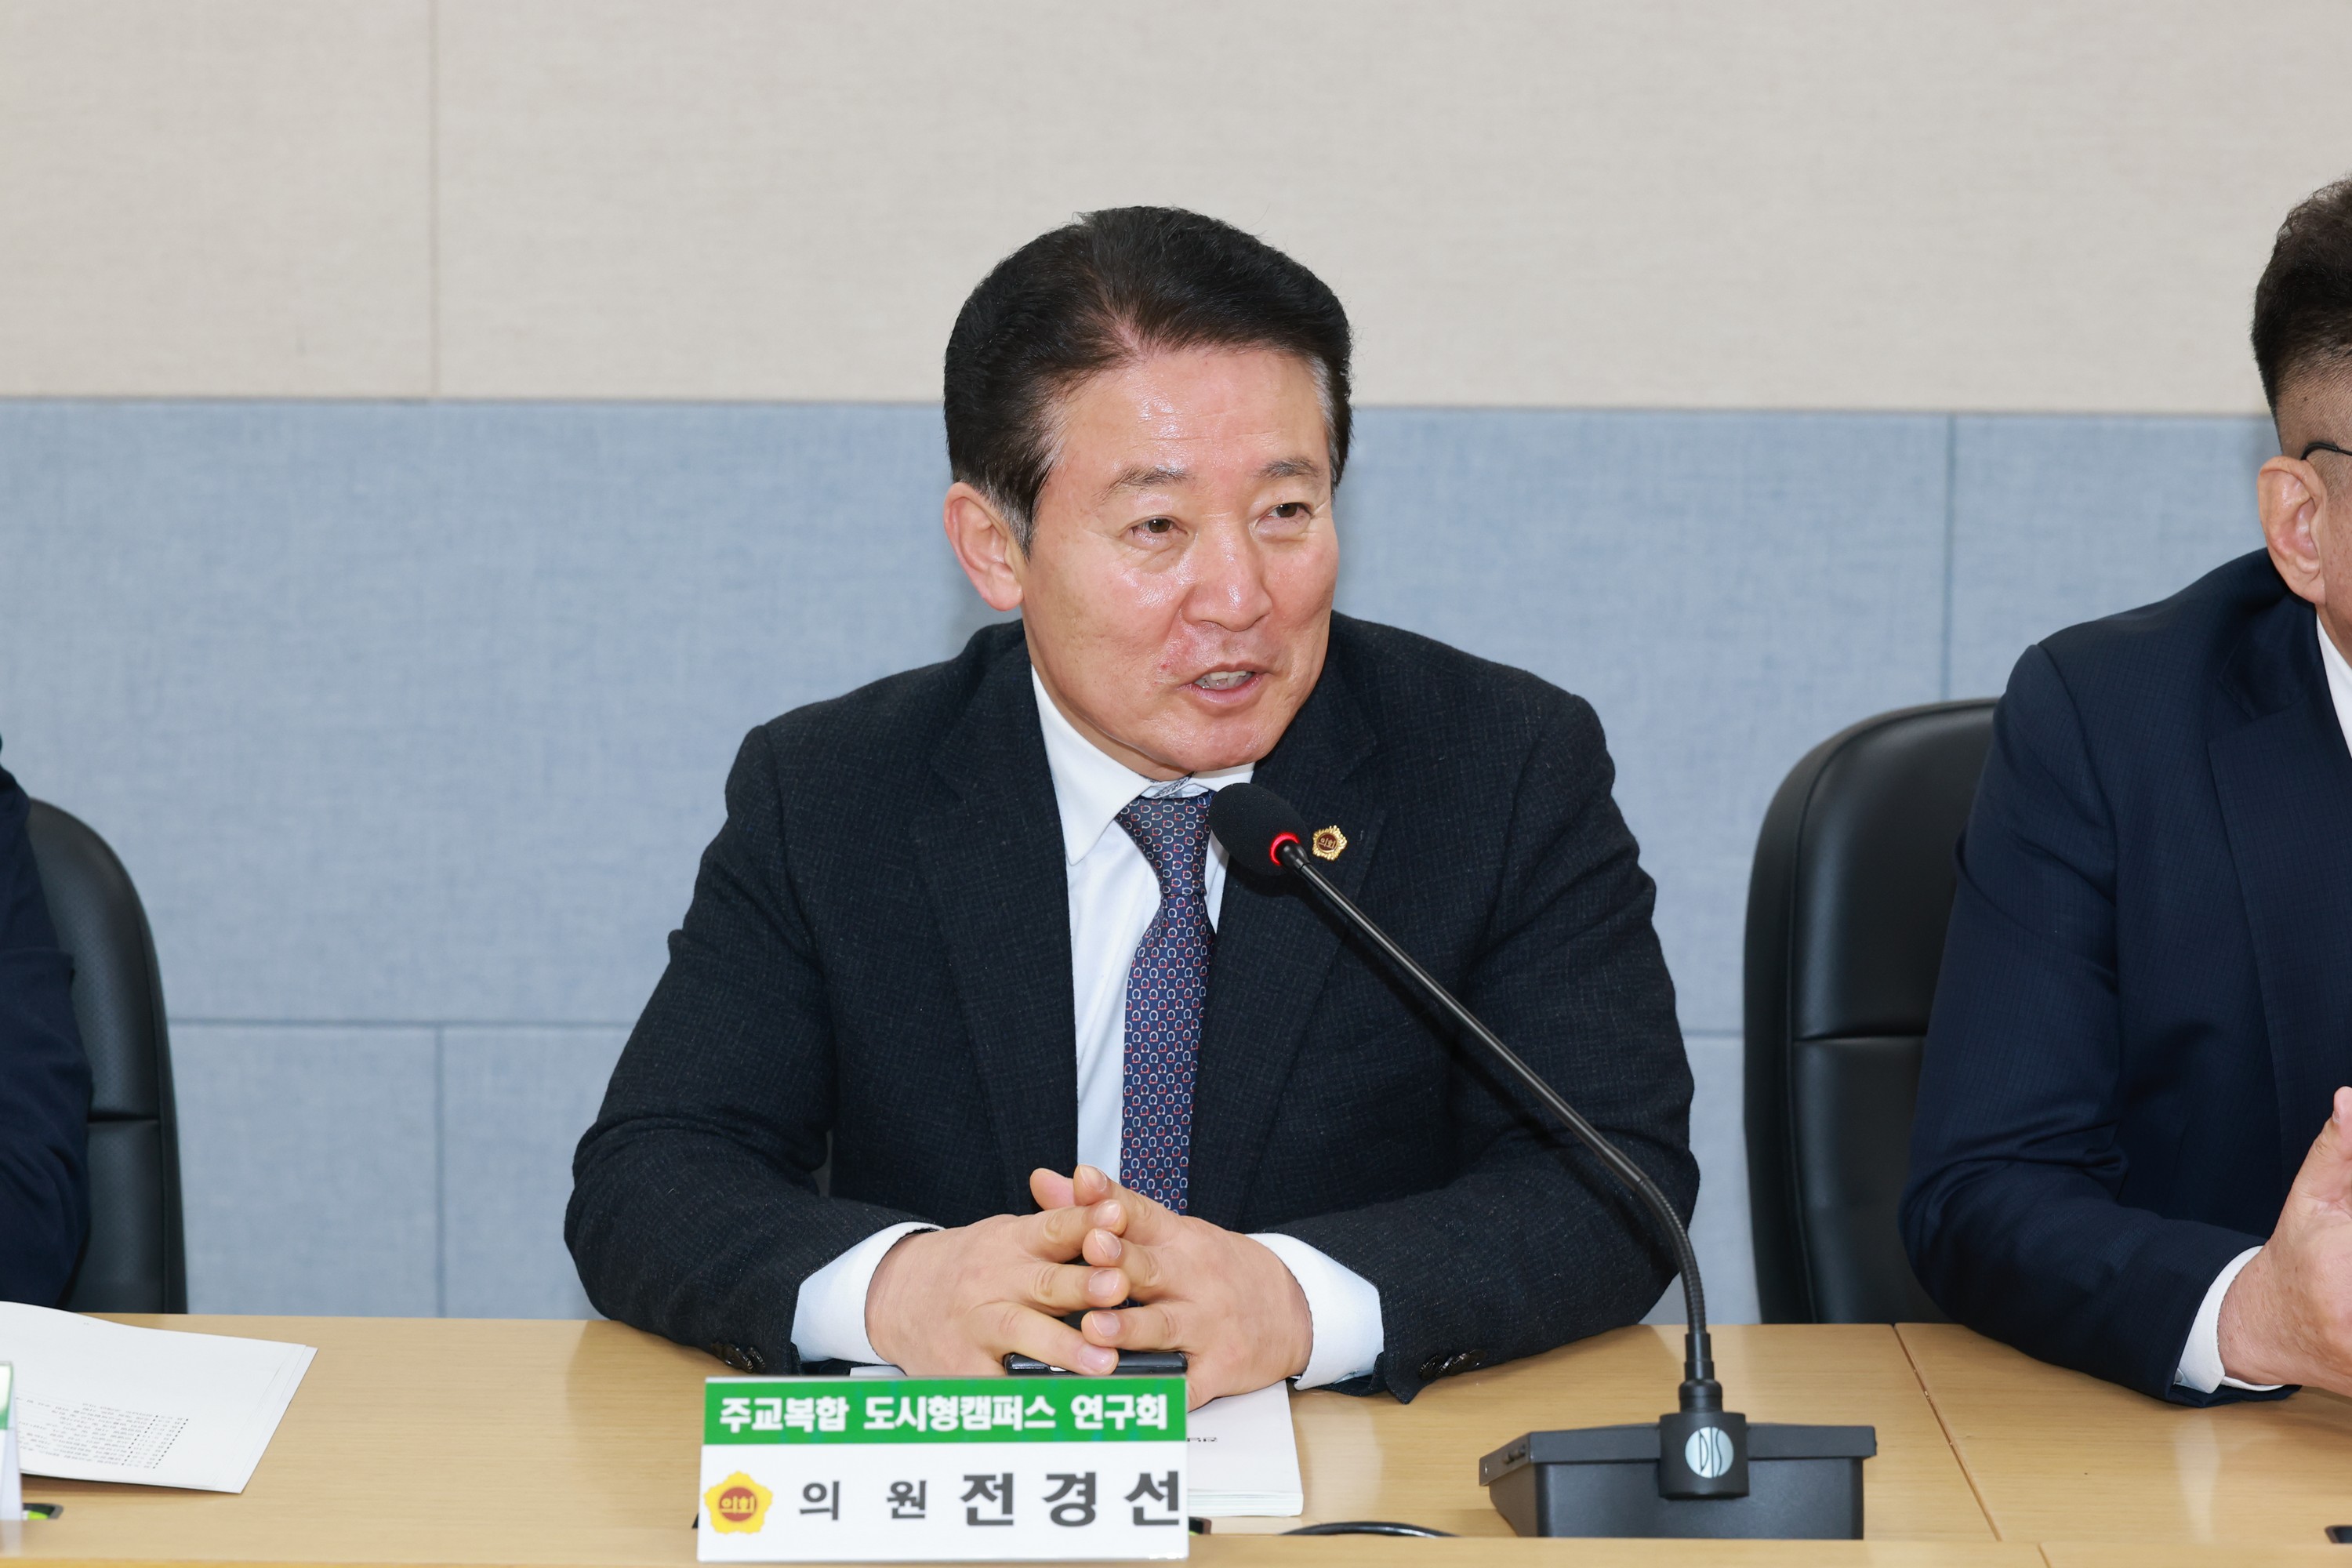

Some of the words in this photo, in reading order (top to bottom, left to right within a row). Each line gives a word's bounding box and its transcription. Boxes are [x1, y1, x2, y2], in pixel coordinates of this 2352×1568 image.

[720, 1396, 850, 1434] 주교복합
[863, 1394, 1056, 1432] 도시형캠퍼스
[1070, 1393, 1167, 1430] 연구회
[720, 1495, 756, 1514] 의회
